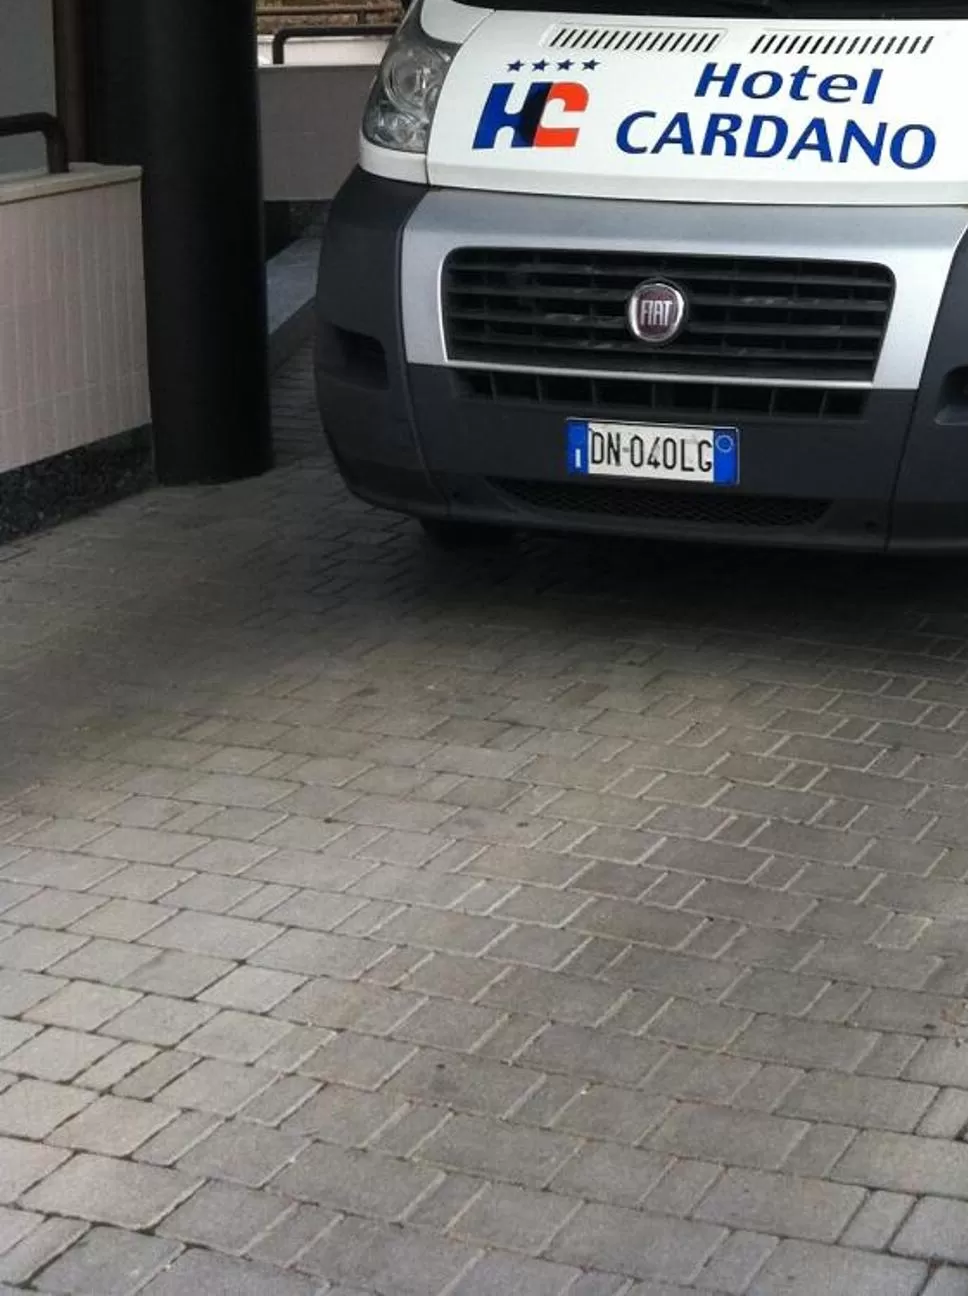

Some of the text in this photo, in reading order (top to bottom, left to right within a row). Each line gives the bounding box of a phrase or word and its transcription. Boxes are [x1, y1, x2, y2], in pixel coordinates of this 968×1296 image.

[694, 61, 884, 105] Hotel
[616, 110, 937, 171] CARDANO
[640, 299, 673, 327] FIAT
